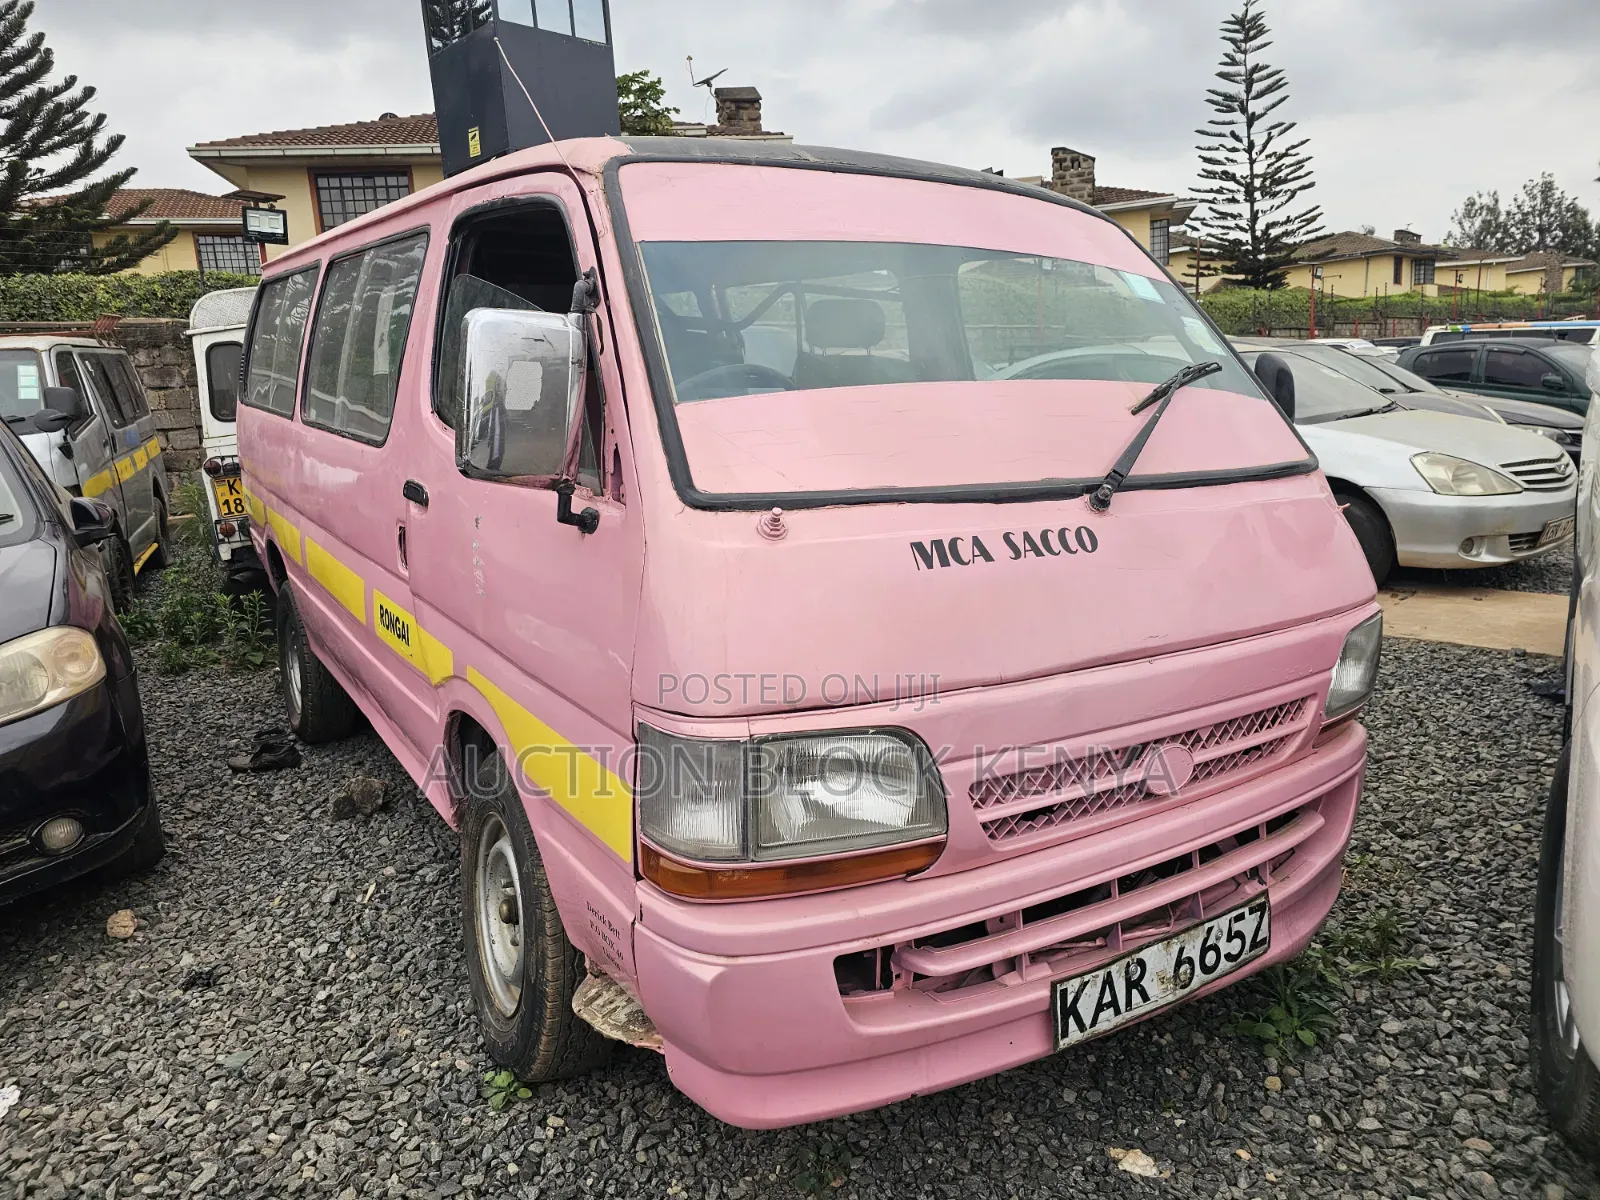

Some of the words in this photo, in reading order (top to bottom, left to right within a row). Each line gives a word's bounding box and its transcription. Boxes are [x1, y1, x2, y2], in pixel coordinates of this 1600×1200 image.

[910, 535, 996, 571] MCA
[1002, 525, 1099, 561] SACCO
[379, 603, 410, 647] RONGAI
[1058, 957, 1151, 1040] KAR
[1172, 901, 1269, 990] 665Z
